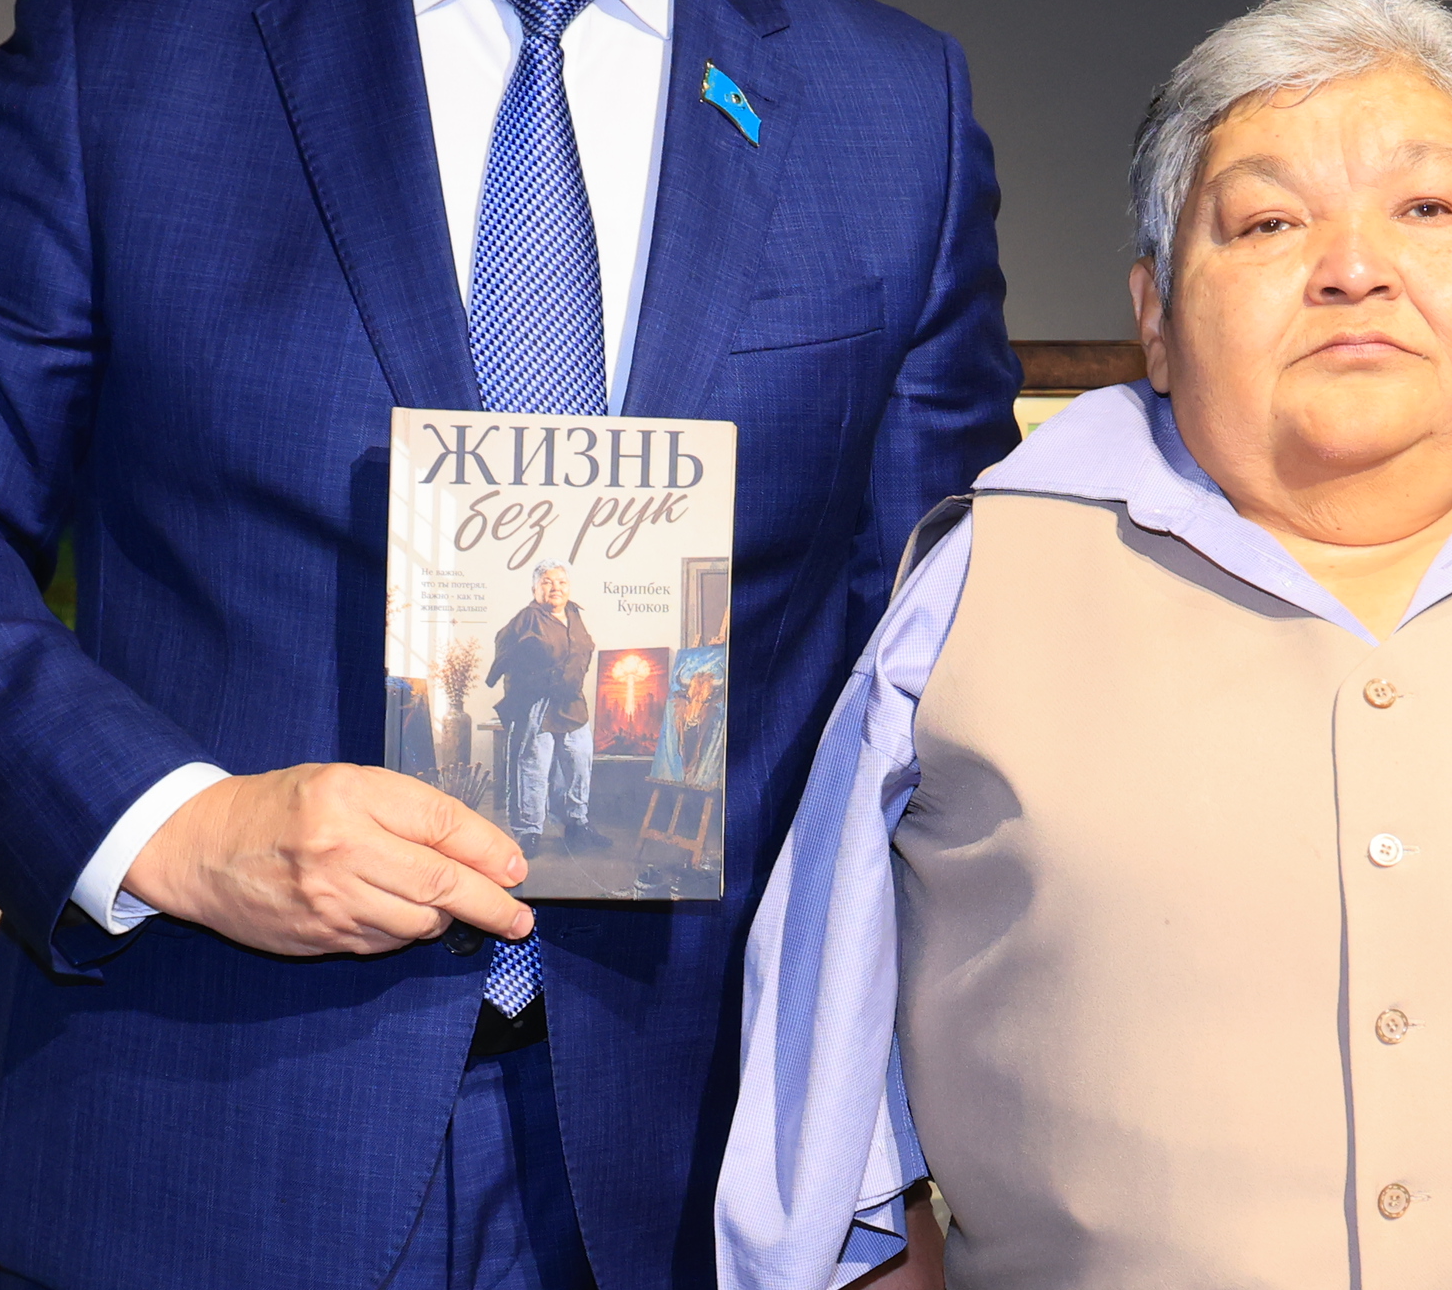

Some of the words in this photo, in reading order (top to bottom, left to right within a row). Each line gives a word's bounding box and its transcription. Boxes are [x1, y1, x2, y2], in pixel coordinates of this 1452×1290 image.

[418, 423, 704, 488] ЖИЗНЬ
[453, 490, 559, 571] без
[568, 491, 689, 565] рук
[421, 567, 434, 577] Не
[421, 580, 436, 589] что
[437, 580, 450, 589] ты
[451, 581, 488, 591] потерял.
[603, 581, 671, 598] Карипбек
[421, 591, 450, 601] Важно
[456, 593, 473, 601] как
[474, 593, 485, 601] ты
[455, 604, 488, 613] дальше
[617, 599, 670, 616] Куюков
